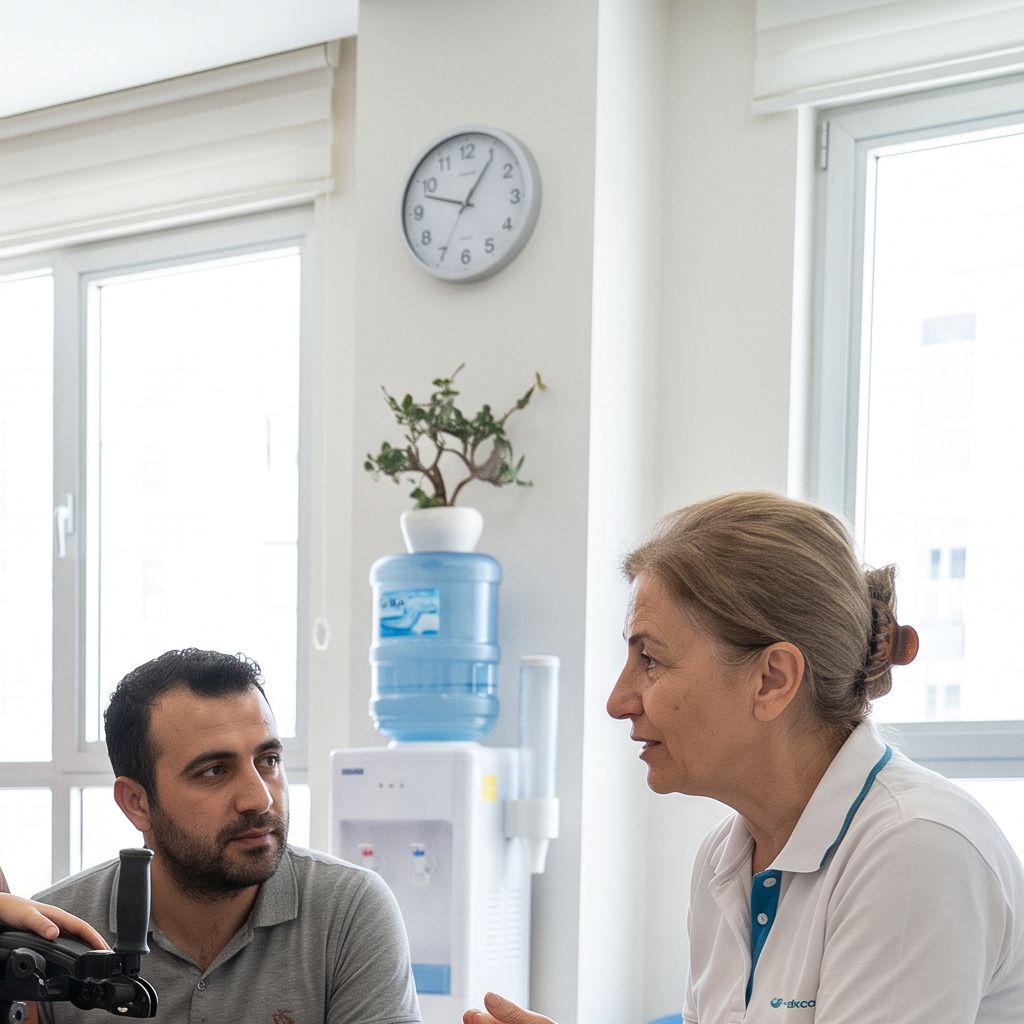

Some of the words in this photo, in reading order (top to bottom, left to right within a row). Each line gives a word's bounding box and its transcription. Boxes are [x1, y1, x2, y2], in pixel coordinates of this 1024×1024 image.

[460, 143, 476, 161] 12
[488, 148, 494, 162] 1
[438, 156, 451, 171] 11
[502, 163, 514, 179] 2
[423, 177, 438, 193] 10
[510, 188, 521, 205] 3
[414, 205, 424, 221] 9
[502, 217, 513, 232] 4
[421, 230, 432, 246] 8
[484, 237, 495, 254] 5
[438, 246, 448, 262] 7
[460, 249, 471, 265] 6
